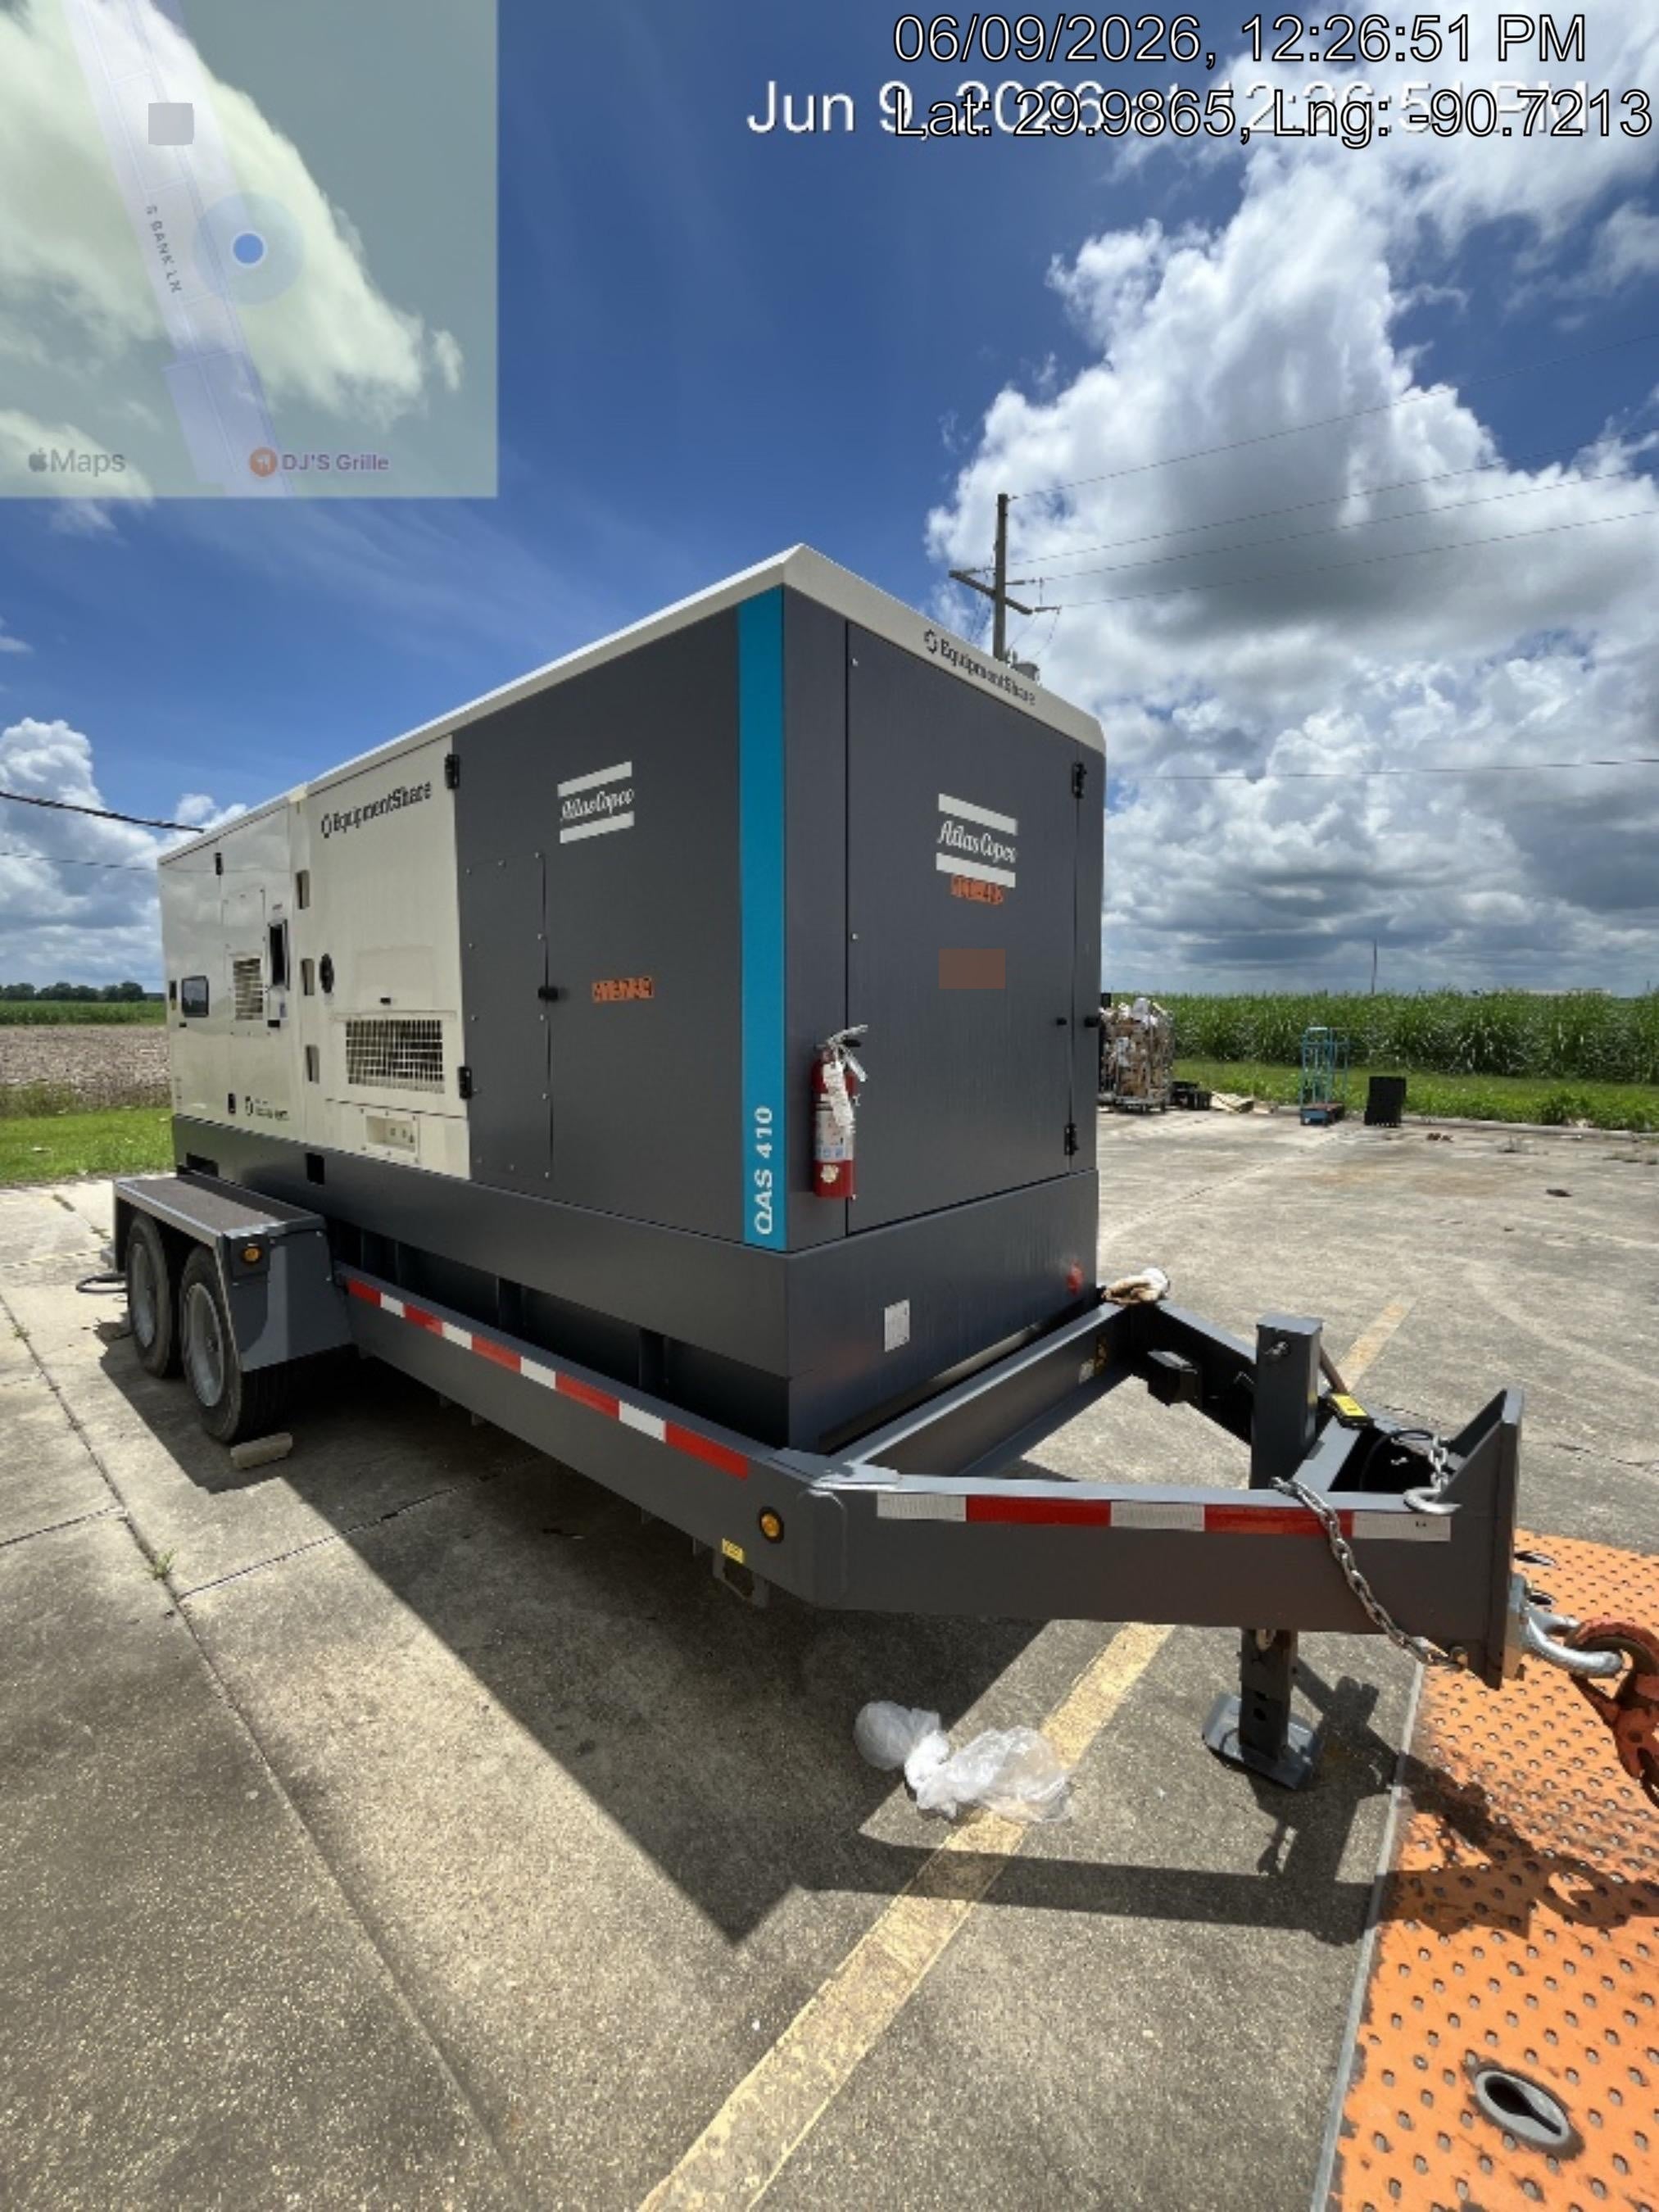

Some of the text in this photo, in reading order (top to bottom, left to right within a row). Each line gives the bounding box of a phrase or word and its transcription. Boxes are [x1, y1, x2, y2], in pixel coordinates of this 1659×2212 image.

[936, 820, 979, 854] Atlas
[754, 1106, 773, 1235] QAS 410
